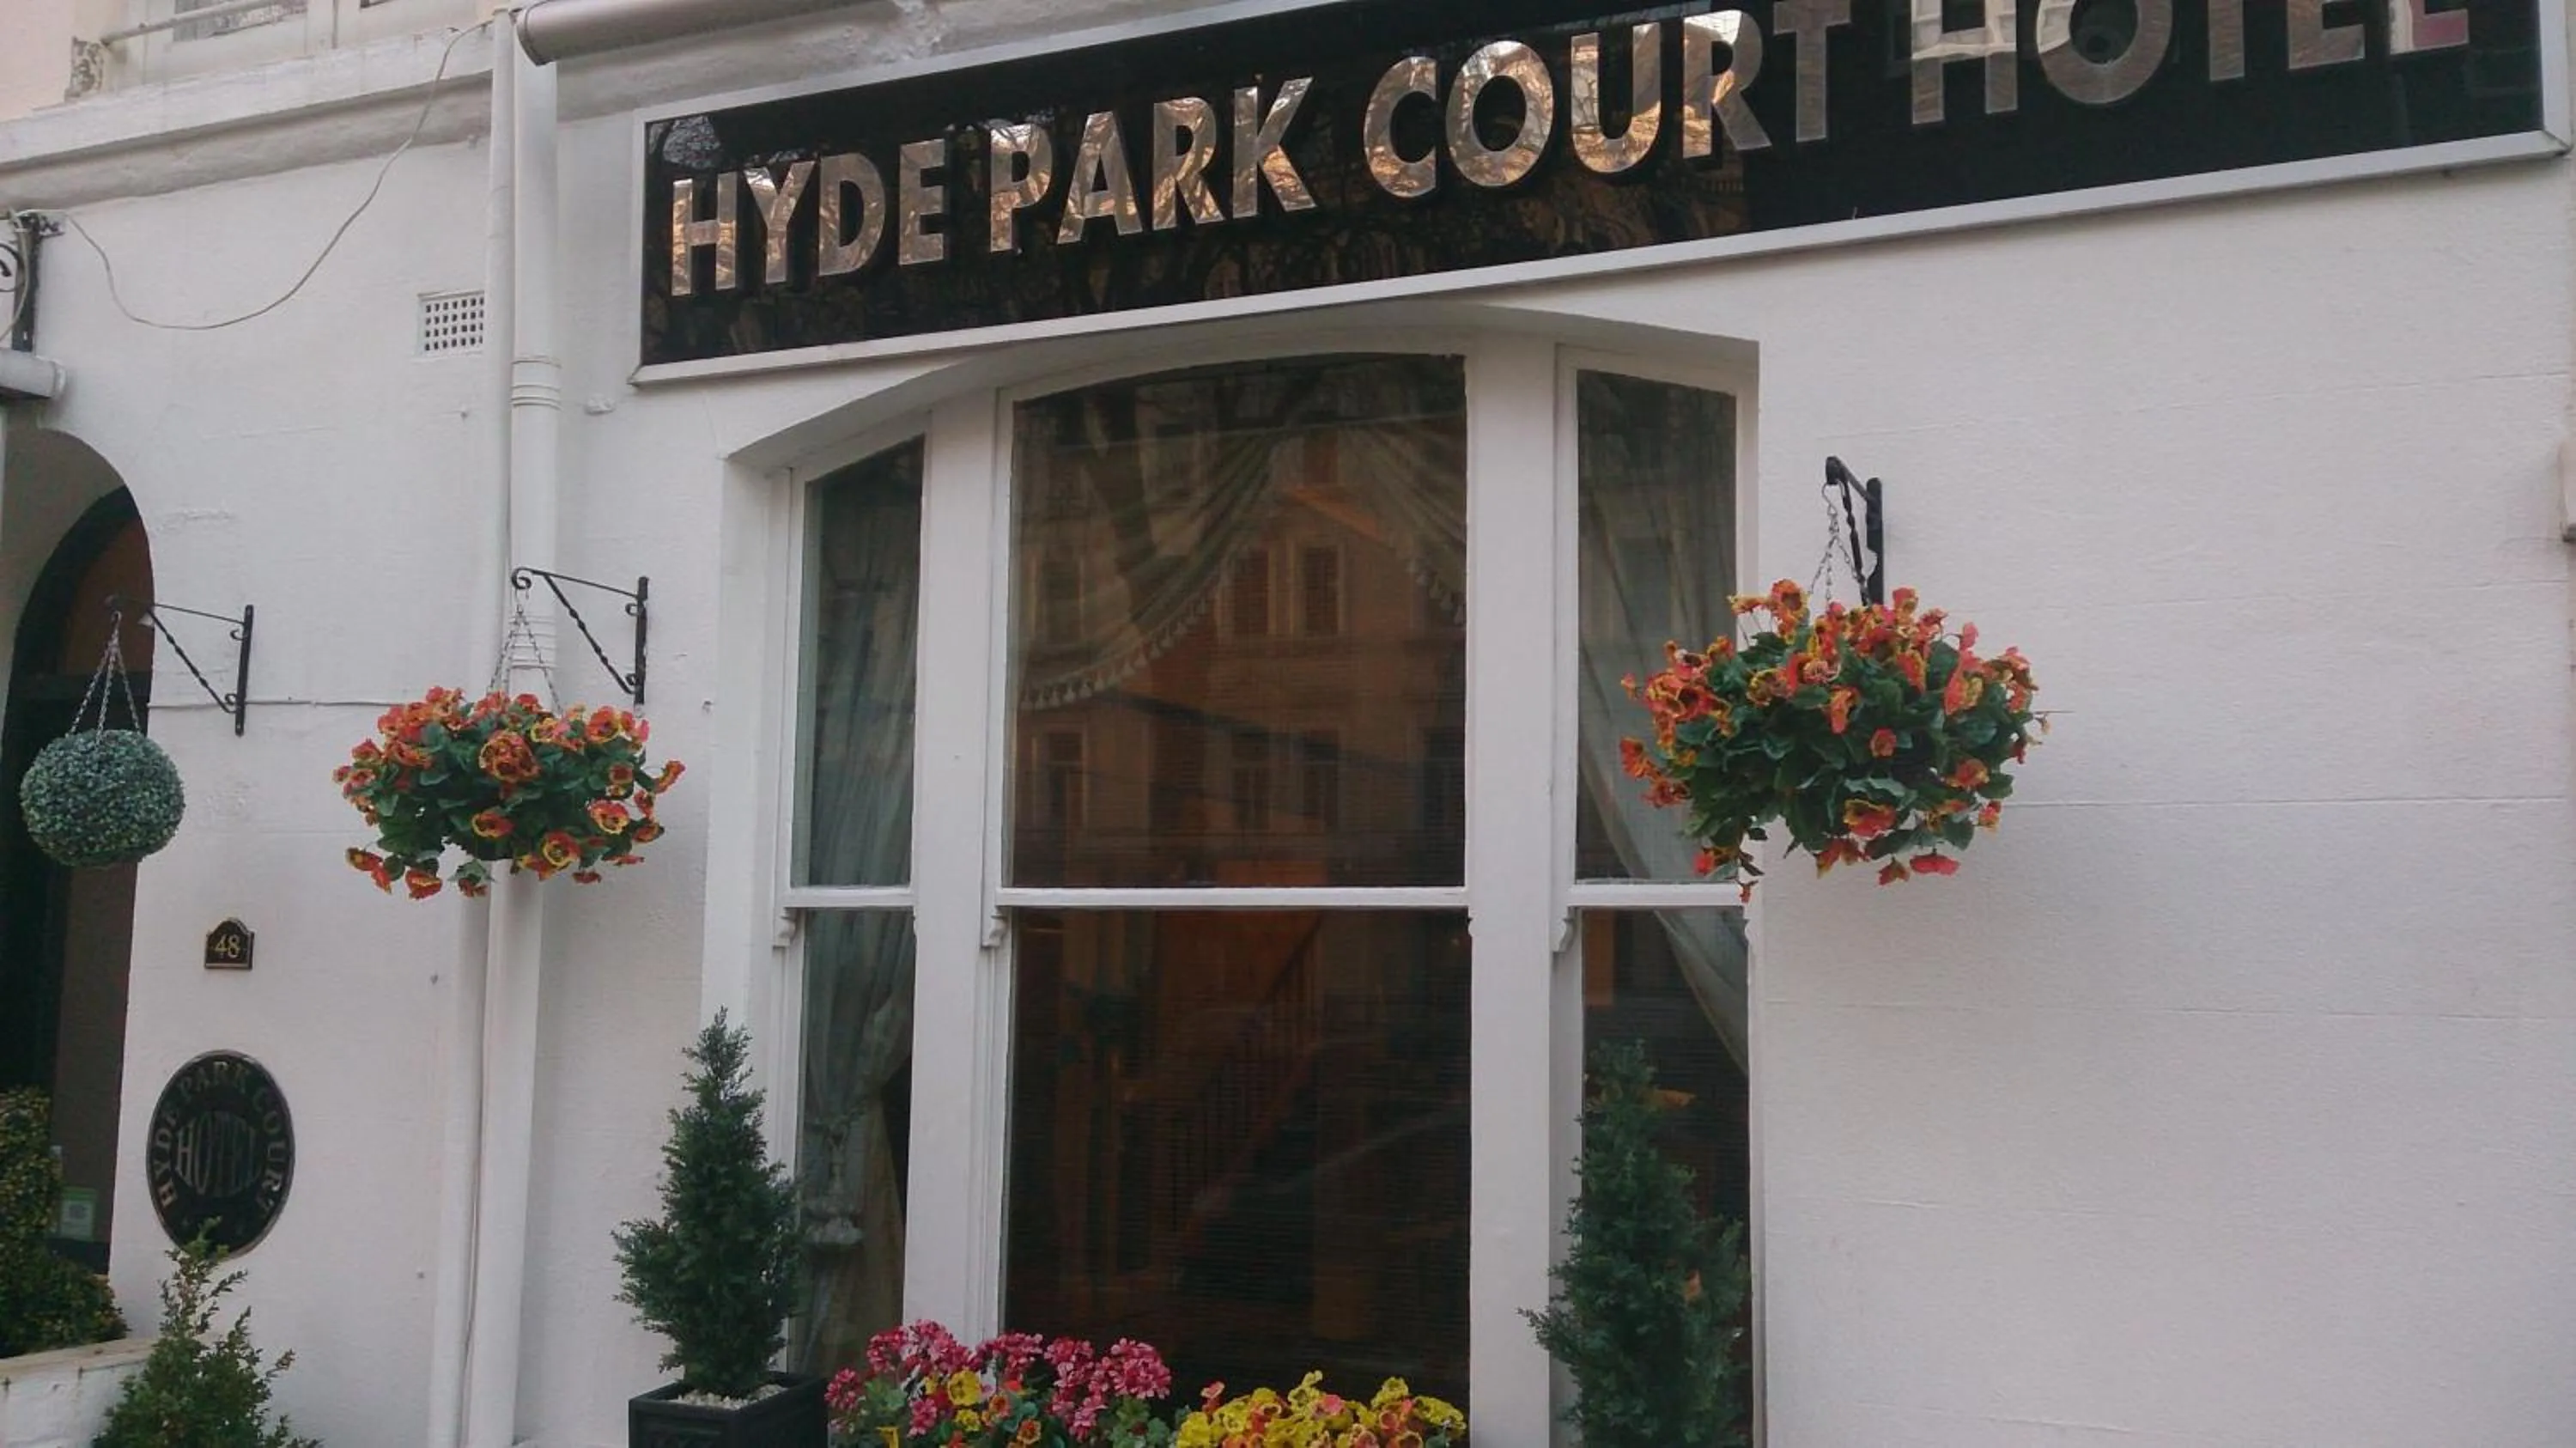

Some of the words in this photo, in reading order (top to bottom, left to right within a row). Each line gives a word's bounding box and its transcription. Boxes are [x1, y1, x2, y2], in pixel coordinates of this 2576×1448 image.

[671, 137, 945, 296] HYDE
[990, 76, 1316, 252] PARK
[1364, 0, 1850, 198] COURT
[215, 934, 240, 958] 48
[177, 1061, 251, 1102] PARK
